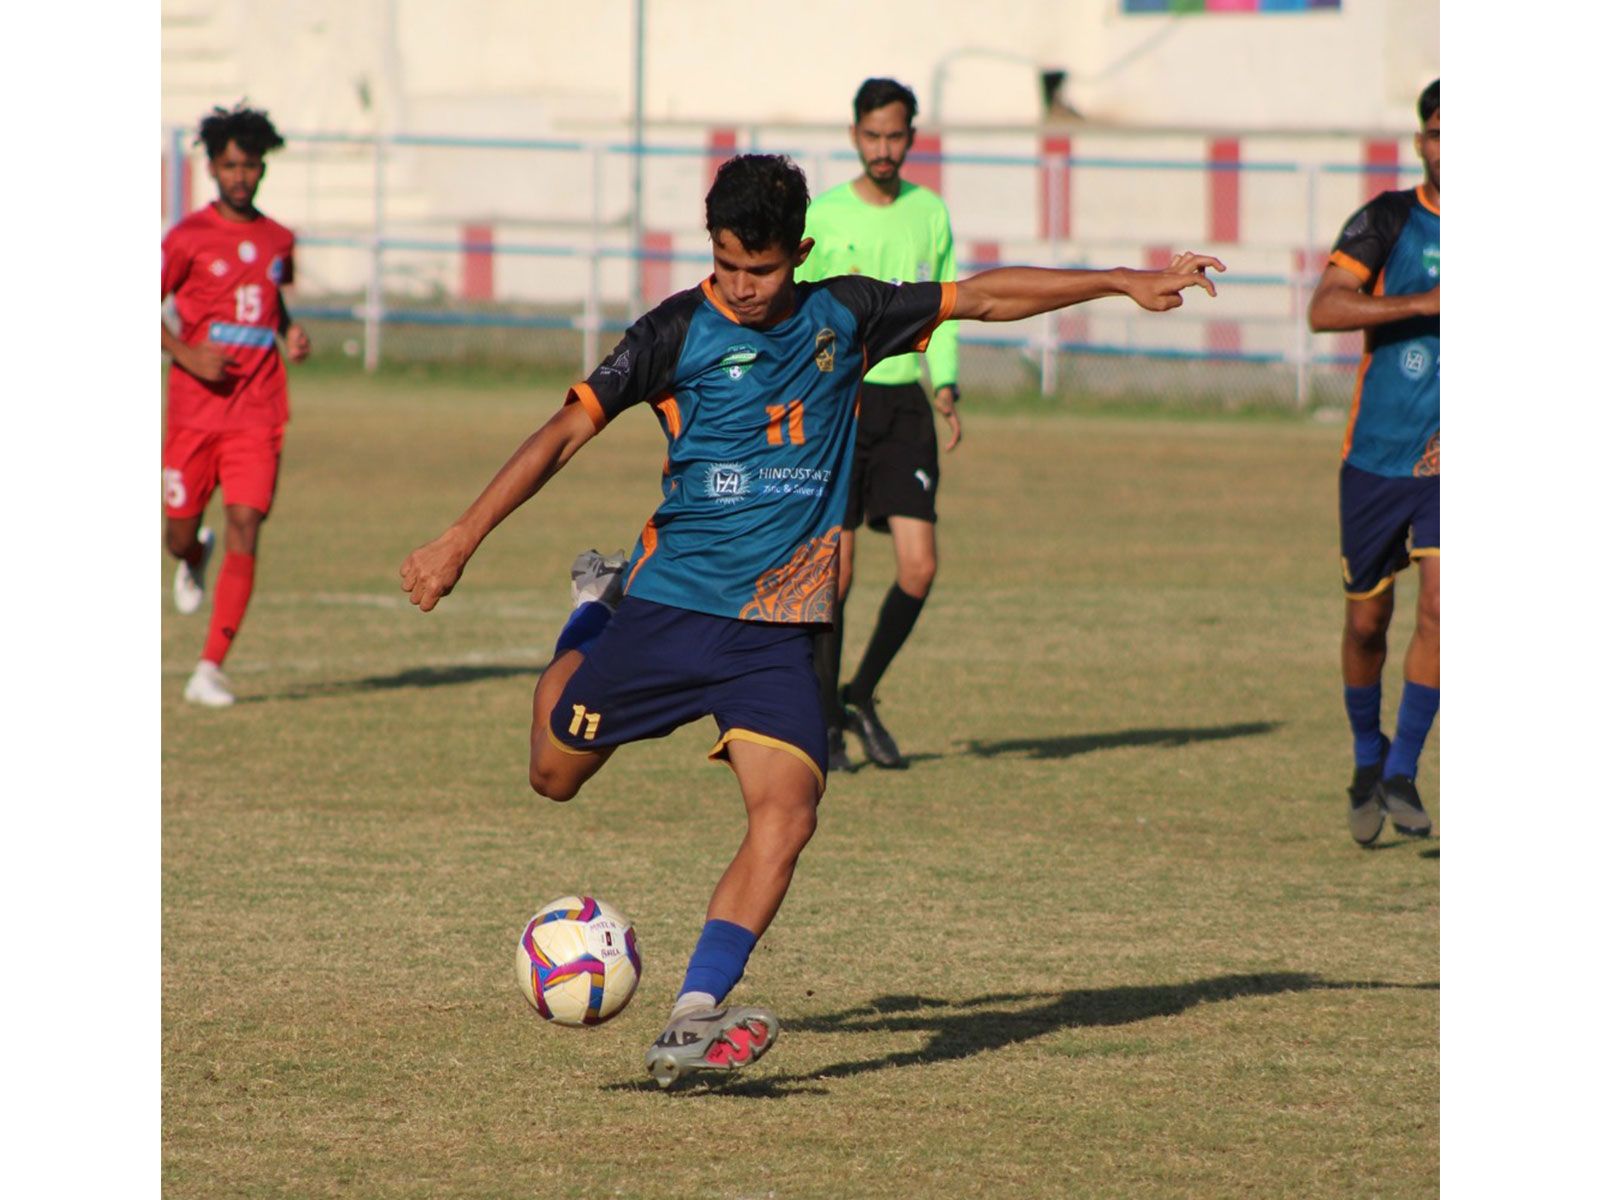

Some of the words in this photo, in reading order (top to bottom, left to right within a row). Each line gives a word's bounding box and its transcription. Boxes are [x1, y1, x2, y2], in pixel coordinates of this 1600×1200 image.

[235, 284, 262, 322] 15
[766, 398, 806, 446] 11
[568, 704, 601, 740] 11
